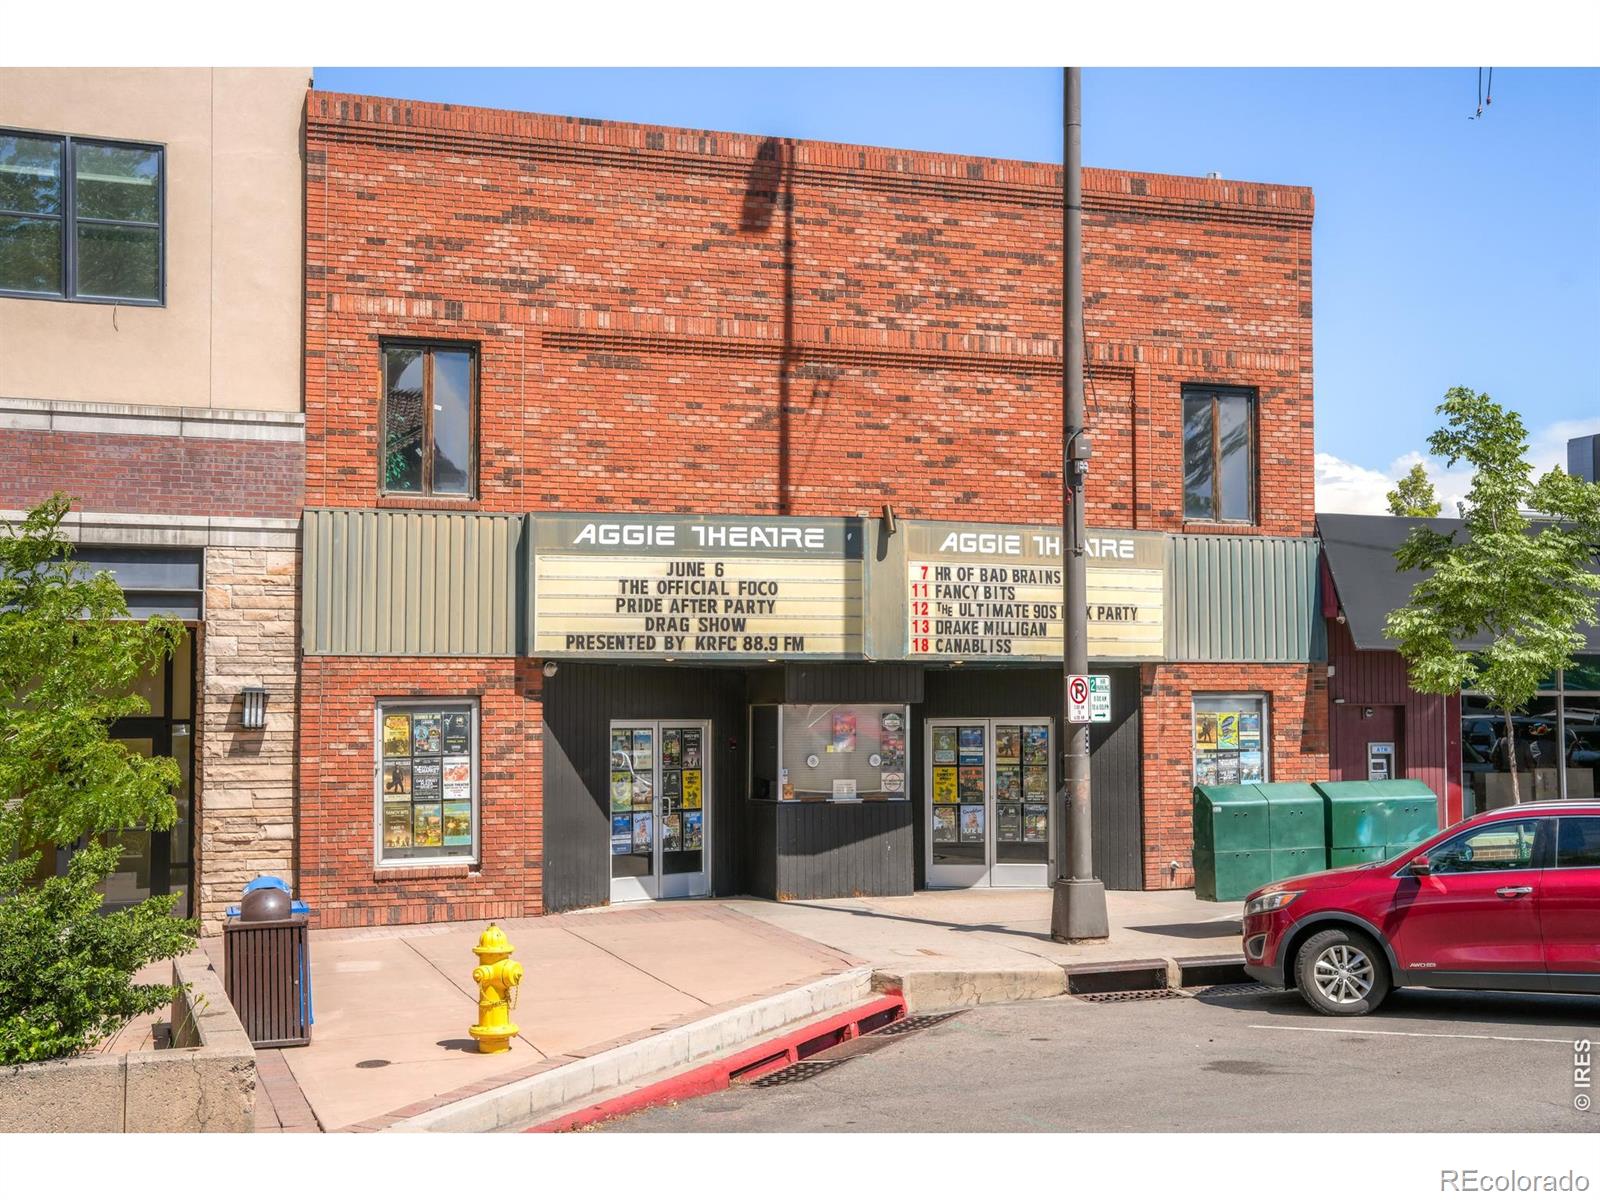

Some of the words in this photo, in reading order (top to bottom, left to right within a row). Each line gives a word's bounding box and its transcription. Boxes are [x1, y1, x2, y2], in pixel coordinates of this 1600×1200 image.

[573, 524, 675, 546] AGGIE
[691, 526, 825, 548] THEATRE
[939, 532, 1020, 554] AGGIE
[1033, 535, 1134, 558] THTRE
[666, 562, 705, 577] JUNE
[714, 562, 724, 577] 6
[921, 566, 928, 580] 7
[935, 566, 951, 581] HR
[957, 567, 974, 582] OF
[980, 568, 1007, 582] BAD
[1012, 569, 1061, 584] BRAINS
[619, 579, 648, 595] THE
[657, 580, 729, 596] OFFICIAL
[738, 581, 778, 596] FOCO
[912, 584, 928, 597] 11
[935, 584, 979, 600] FANCY
[984, 586, 1015, 600] BITS
[616, 598, 663, 613] PRIDE
[669, 599, 717, 614] AFTER
[724, 600, 776, 614] PARTY
[912, 602, 929, 616] 12
[937, 603, 952, 616] THE
[959, 603, 1029, 618] ULTIMATE
[1033, 604, 1057, 619] 90S
[1097, 606, 1138, 621] PARTY
[645, 617, 689, 632] DRAG
[698, 617, 747, 632] SHOW
[912, 620, 929, 634] 13
[935, 621, 979, 635] DRAKE
[984, 622, 1047, 637] MILLIGAN
[565, 634, 656, 650] PRESENTED
[664, 635, 686, 651] BY
[695, 636, 736, 651] KRFC
[742, 636, 778, 651] 88.9
[784, 636, 804, 652] FM
[912, 638, 929, 652] 18
[935, 639, 1012, 654] CANABLISS
